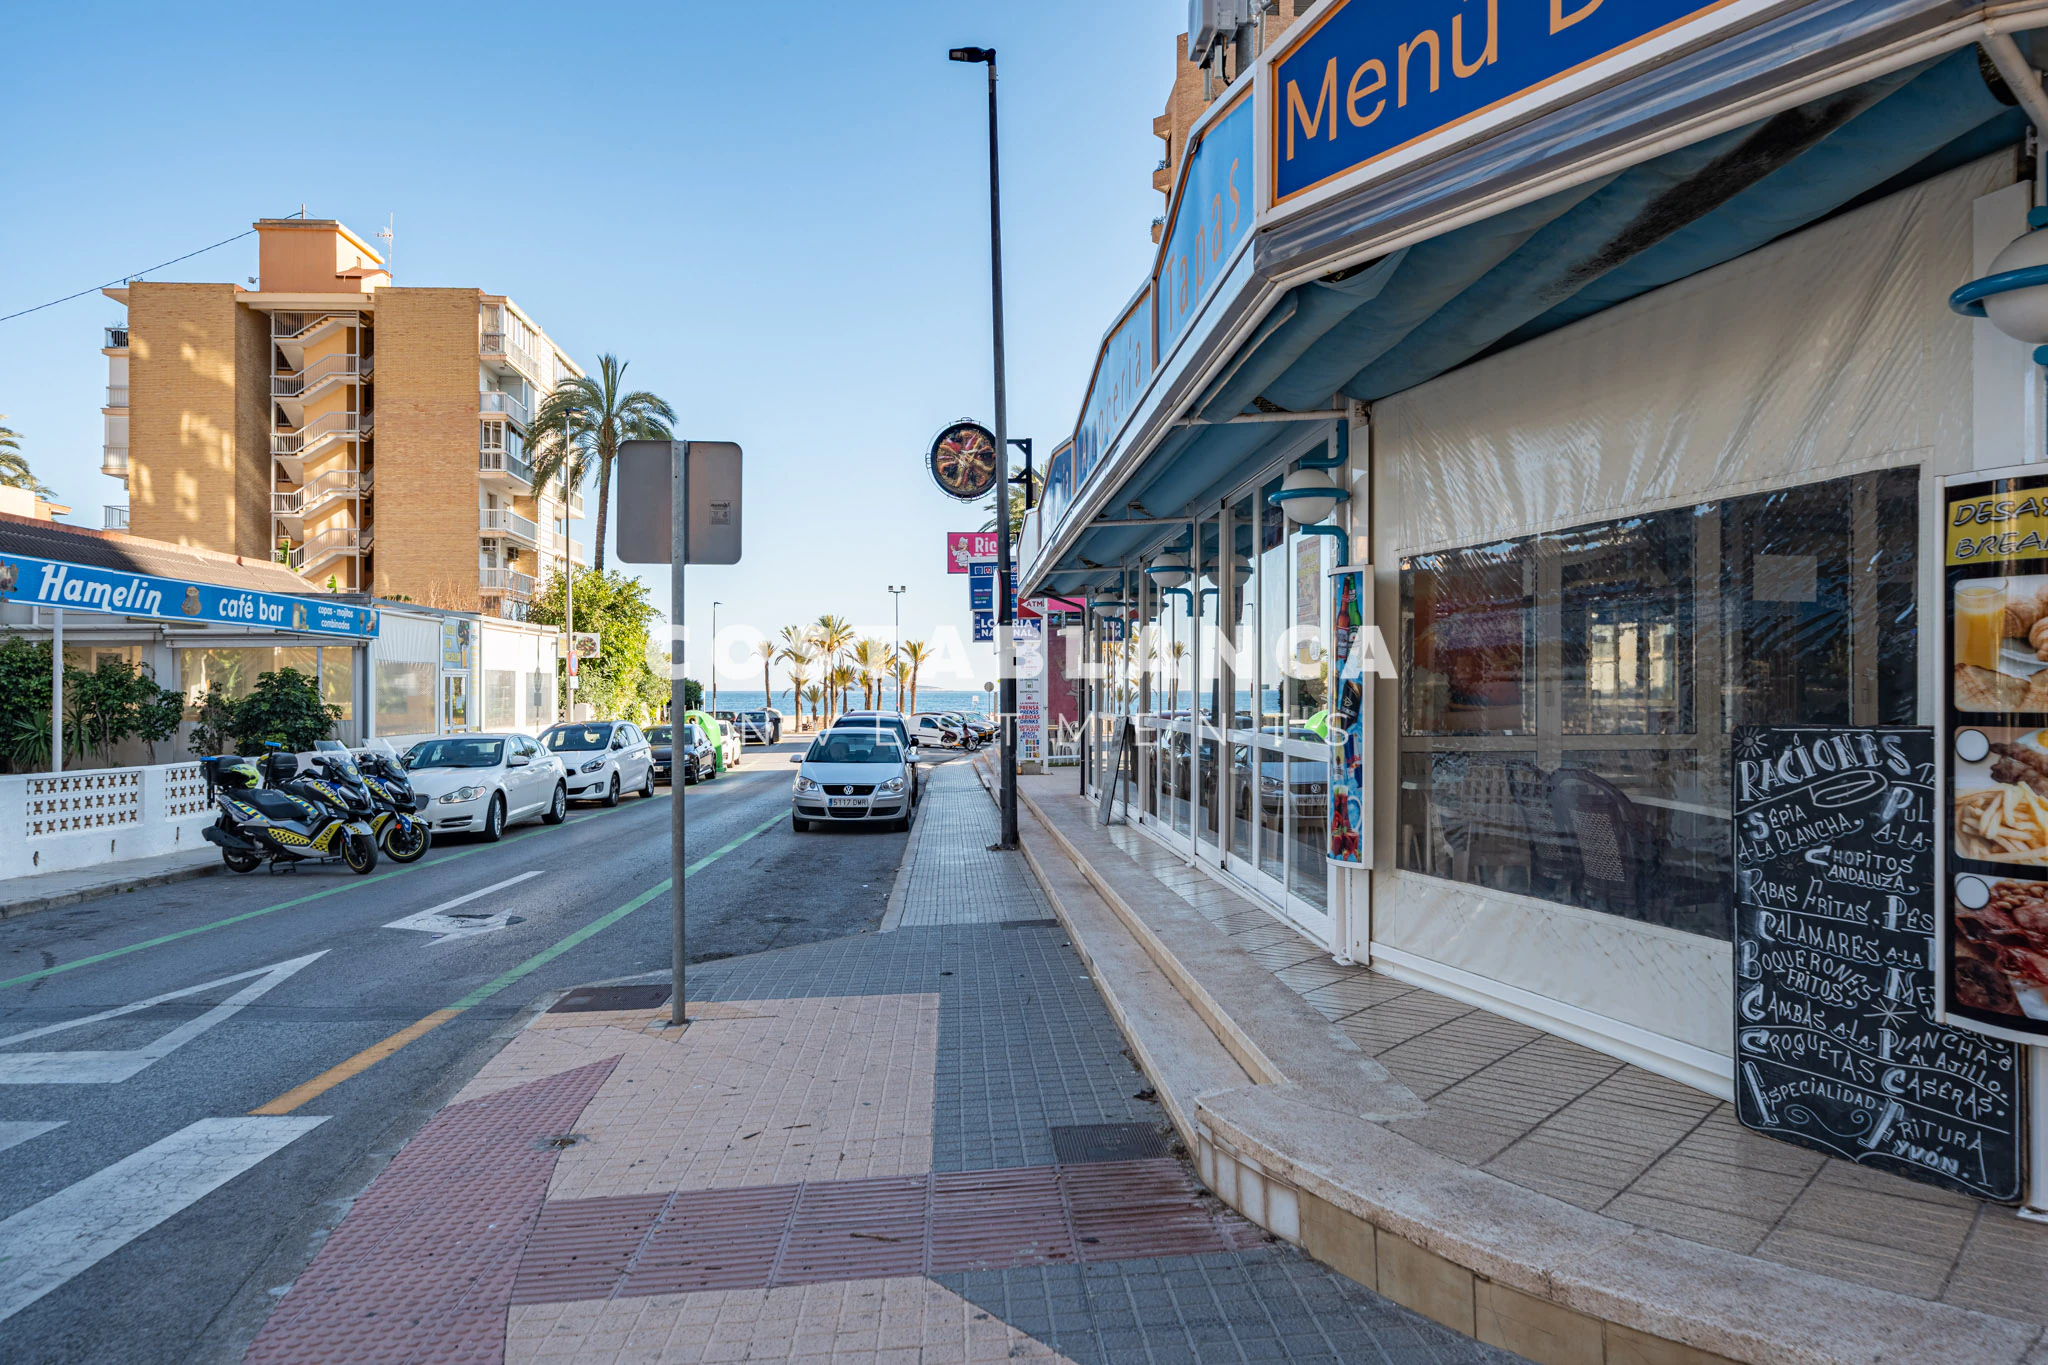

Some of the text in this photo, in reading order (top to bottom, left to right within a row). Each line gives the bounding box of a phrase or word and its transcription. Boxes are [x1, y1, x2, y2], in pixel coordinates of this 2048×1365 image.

[1165, 157, 1241, 333] Tapas
[974, 536, 999, 553] Ric
[37, 563, 162, 617] Hamelin
[219, 593, 284, 622] café bar
[318, 606, 333, 616] copas
[336, 608, 354, 619] mojitos
[1026, 600, 1043, 608] ATM
[321, 618, 350, 630] combinados
[1738, 733, 1912, 801] RACIONES
[1880, 786, 1935, 823] PUL
[1805, 844, 1916, 876] CHOPITOS
[1738, 868, 1798, 908] RABAS
[1882, 894, 1935, 931] PES
[1757, 910, 1880, 963] CALAMARES
[1739, 940, 1880, 1000] BOQUERONES
[1738, 981, 1827, 1031] GAMBAS
[1739, 1028, 1876, 1084] CROQUETAS
[1909, 1053, 1929, 1067] AL
[1856, 1098, 1993, 1188] FRITURA
